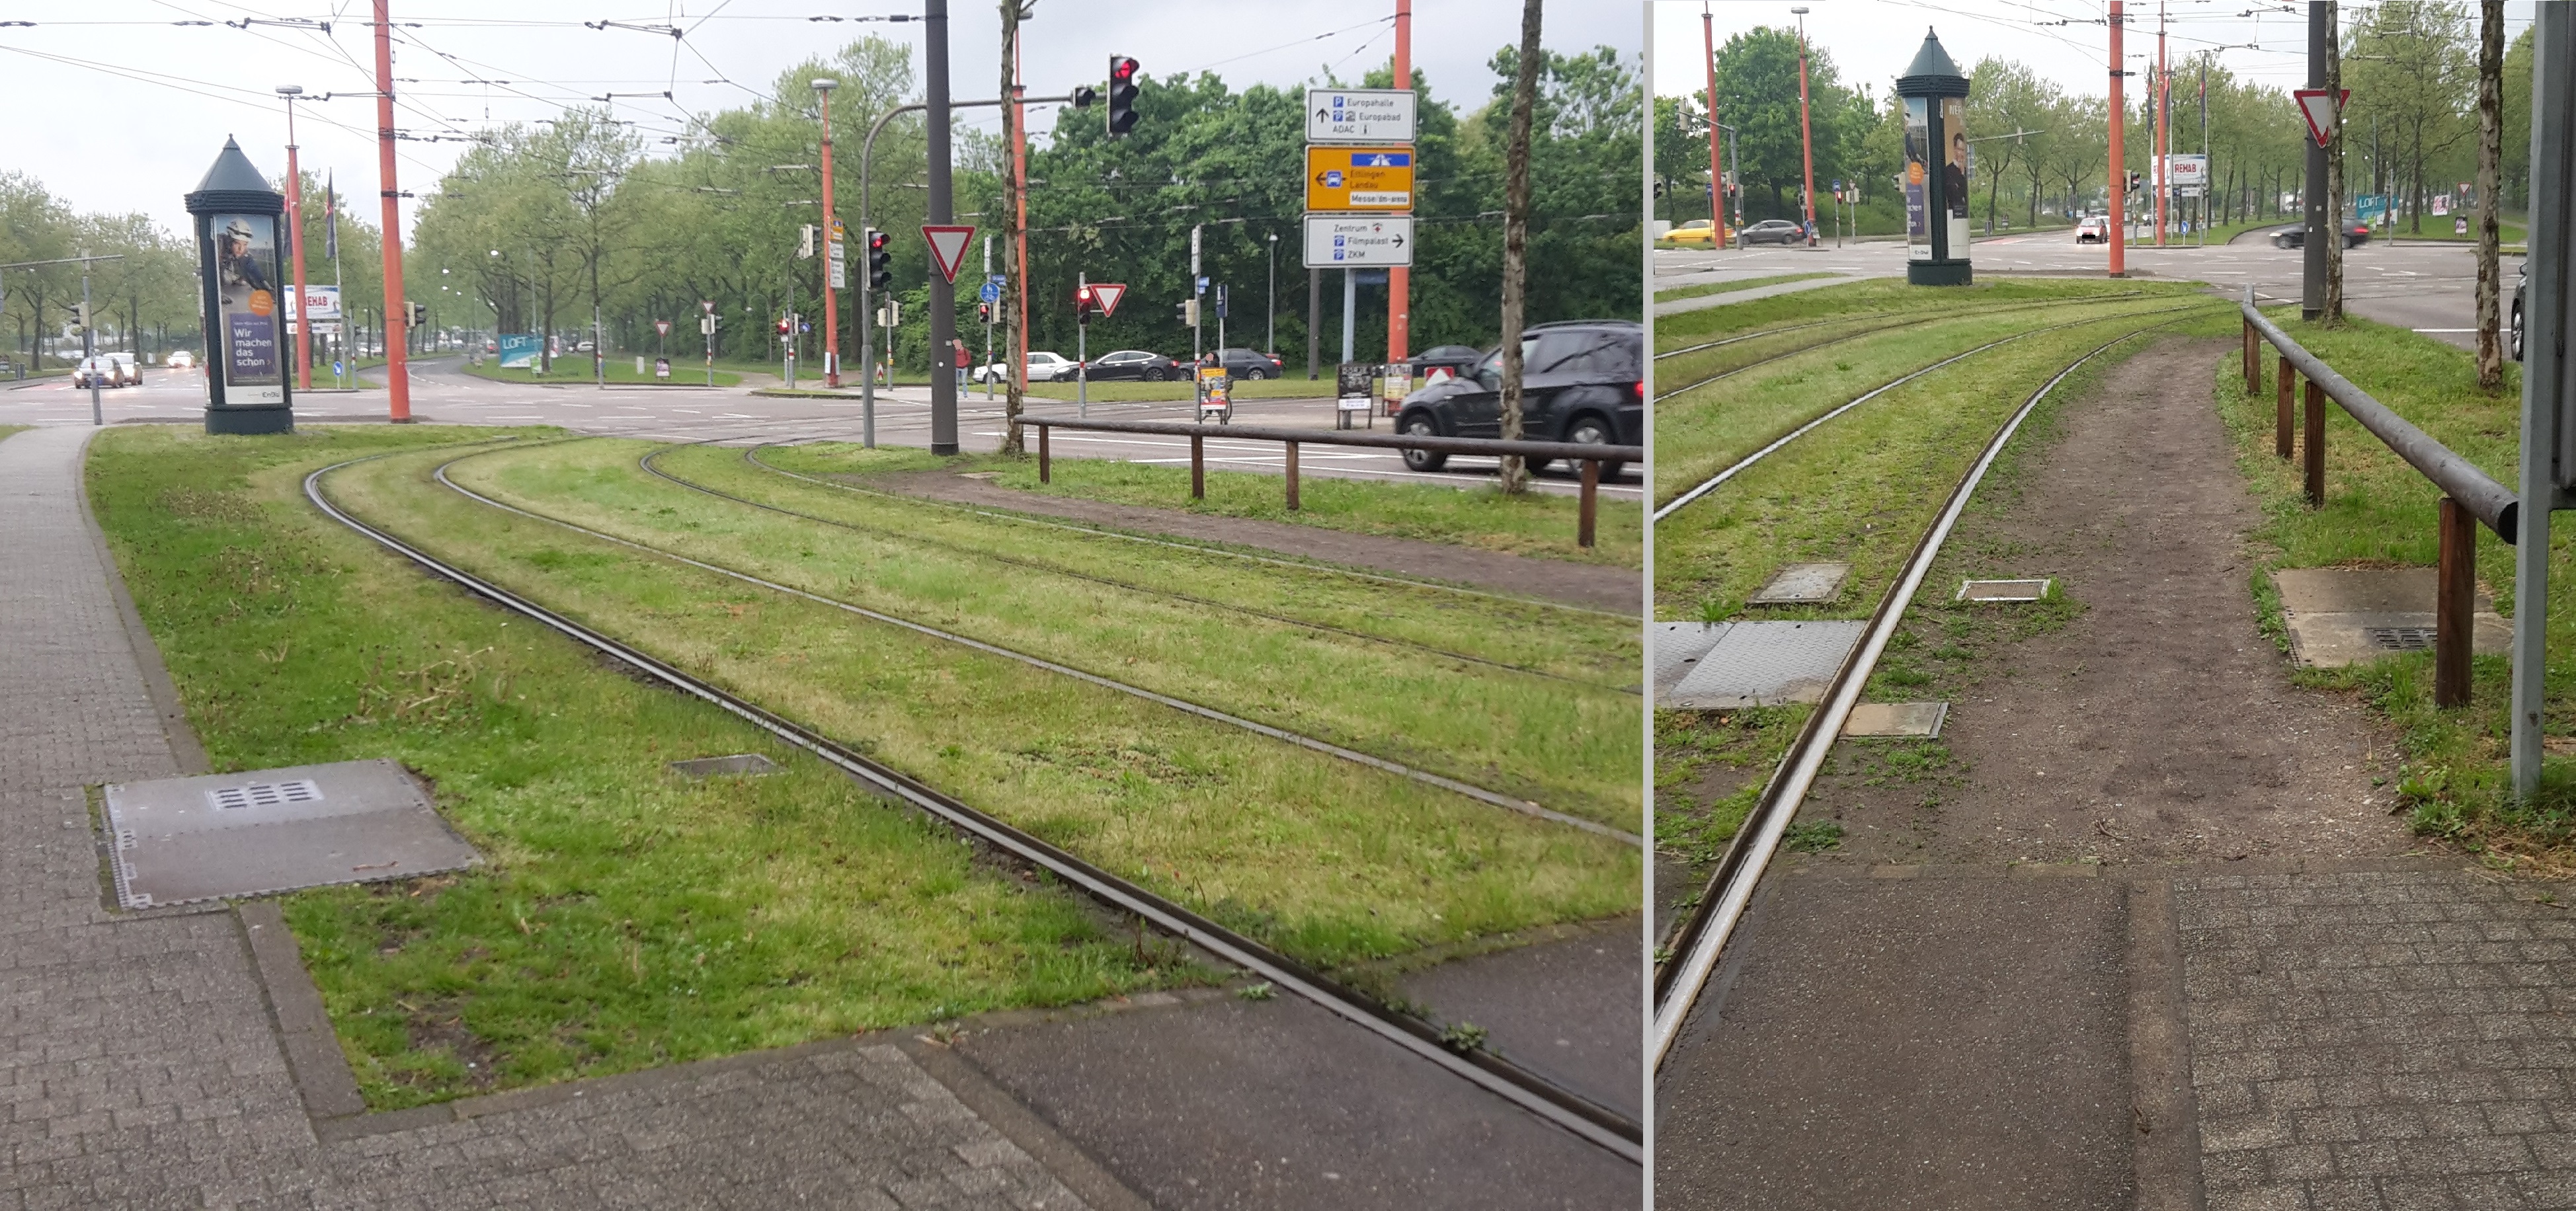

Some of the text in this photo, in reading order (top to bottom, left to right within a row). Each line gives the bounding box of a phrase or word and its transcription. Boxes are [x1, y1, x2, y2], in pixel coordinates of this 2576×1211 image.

[1348, 98, 1394, 108] Europahalle
[1359, 112, 1401, 122] Europabad
[2175, 164, 2196, 173] REHAB
[1334, 224, 1368, 233] Zentrum
[1348, 237, 1389, 246] Filmpalast
[233, 327, 252, 338] Wir
[235, 338, 272, 348] machen
[503, 336, 528, 350] LOFT
[235, 348, 254, 357] das
[237, 357, 265, 368] schon
